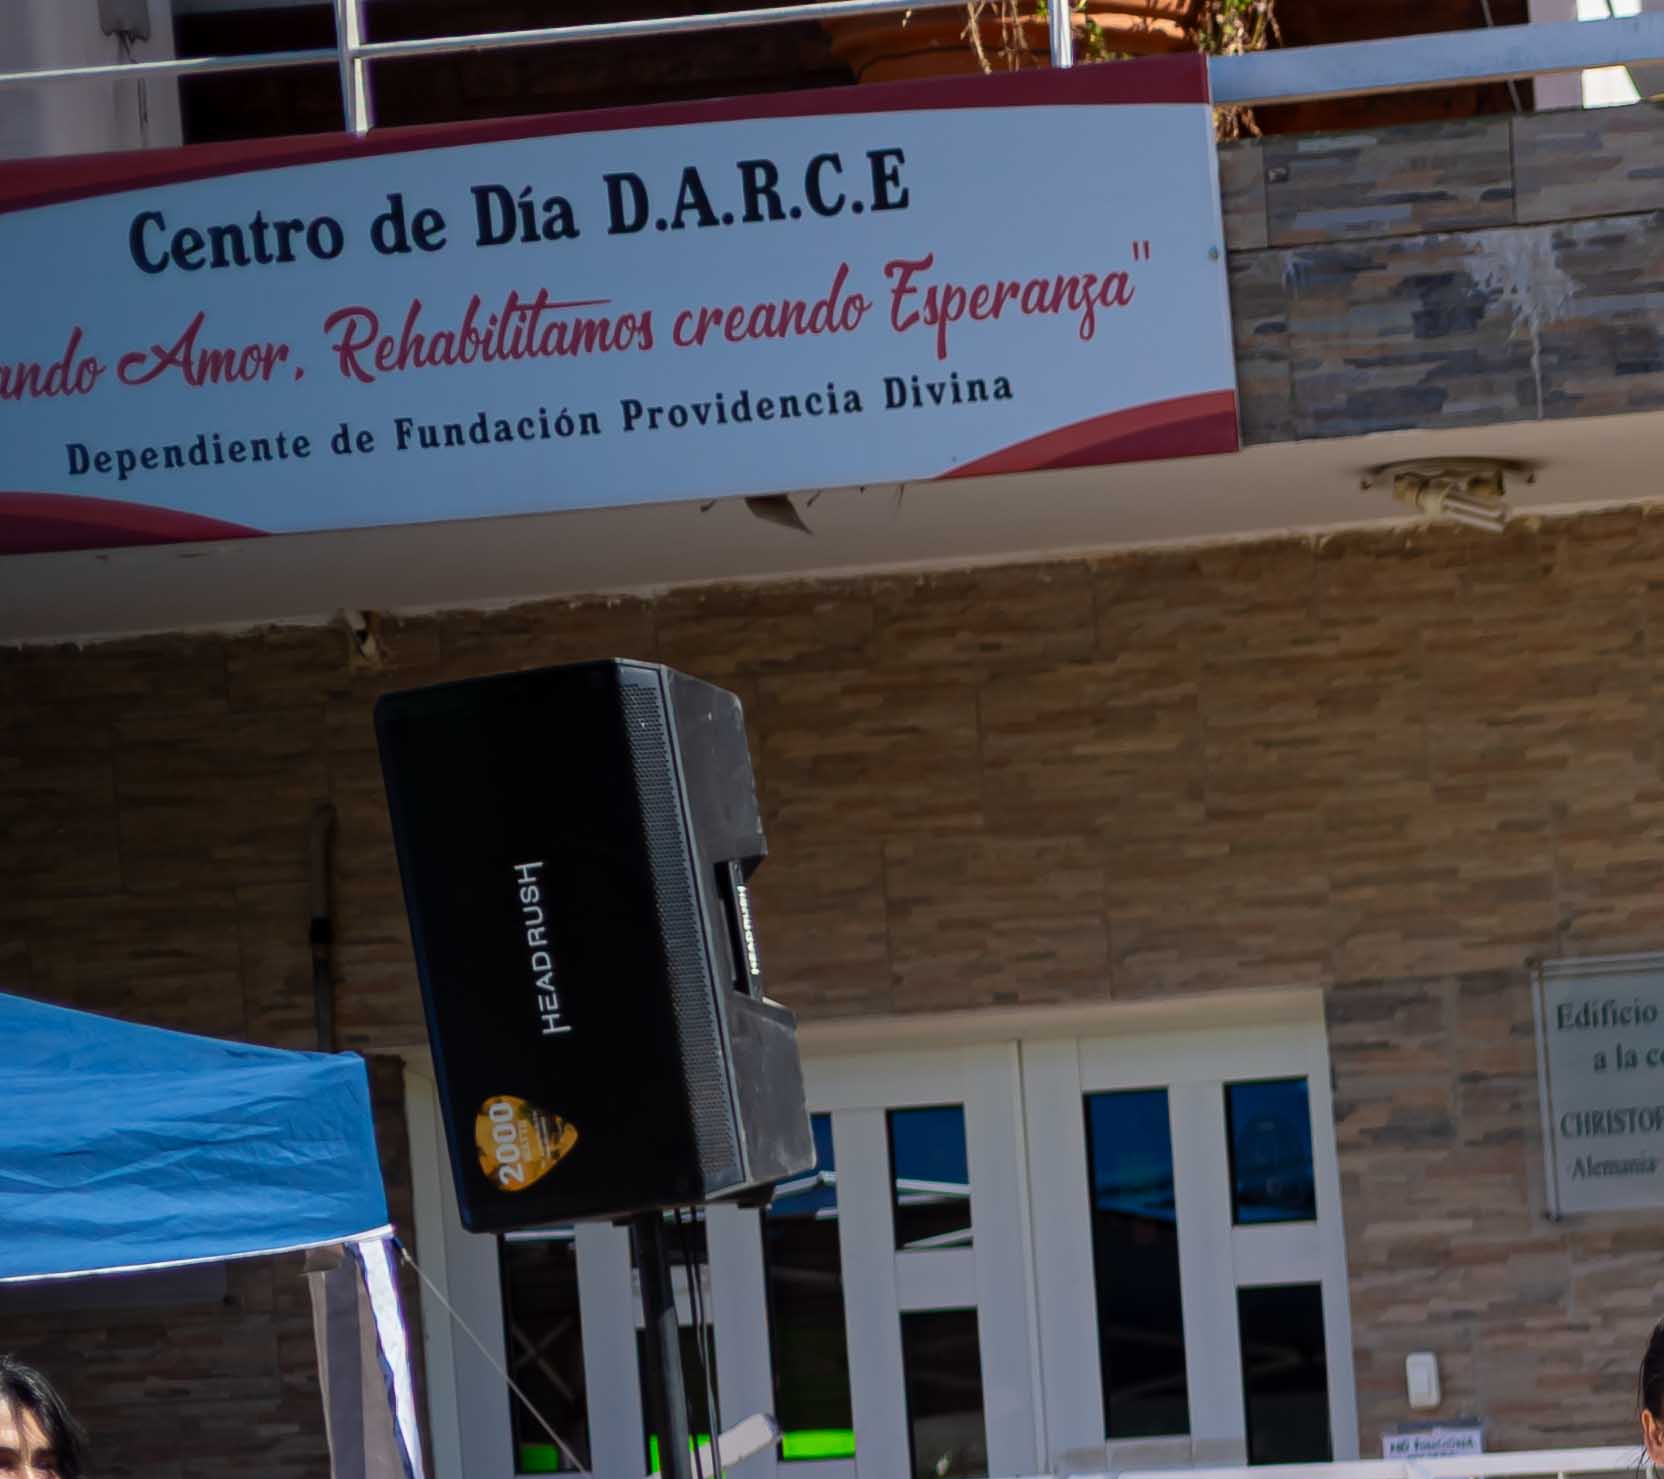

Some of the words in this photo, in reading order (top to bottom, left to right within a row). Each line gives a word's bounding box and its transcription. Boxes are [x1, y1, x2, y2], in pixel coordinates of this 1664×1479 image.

[129, 209, 344, 274] Centro
[370, 194, 446, 256] de
[471, 184, 580, 248] Día
[603, 147, 910, 235] D.A.R.C.E
[323, 288, 653, 384] Rehabilitamos
[673, 262, 872, 349] creando
[67, 433, 311, 481] Dependiente
[331, 424, 375, 456] de
[393, 407, 602, 450] Fundación
[621, 383, 865, 433] Providencia
[883, 372, 1014, 411] Divina
[514, 861, 572, 1037] HEADRUSH
[1557, 998, 1658, 1031] Edificio
[1593, 1053, 1607, 1071] a
[1616, 1043, 1638, 1071] la
[489, 1103, 525, 1185] 2000
[1571, 1154, 1658, 1182] Alemania
